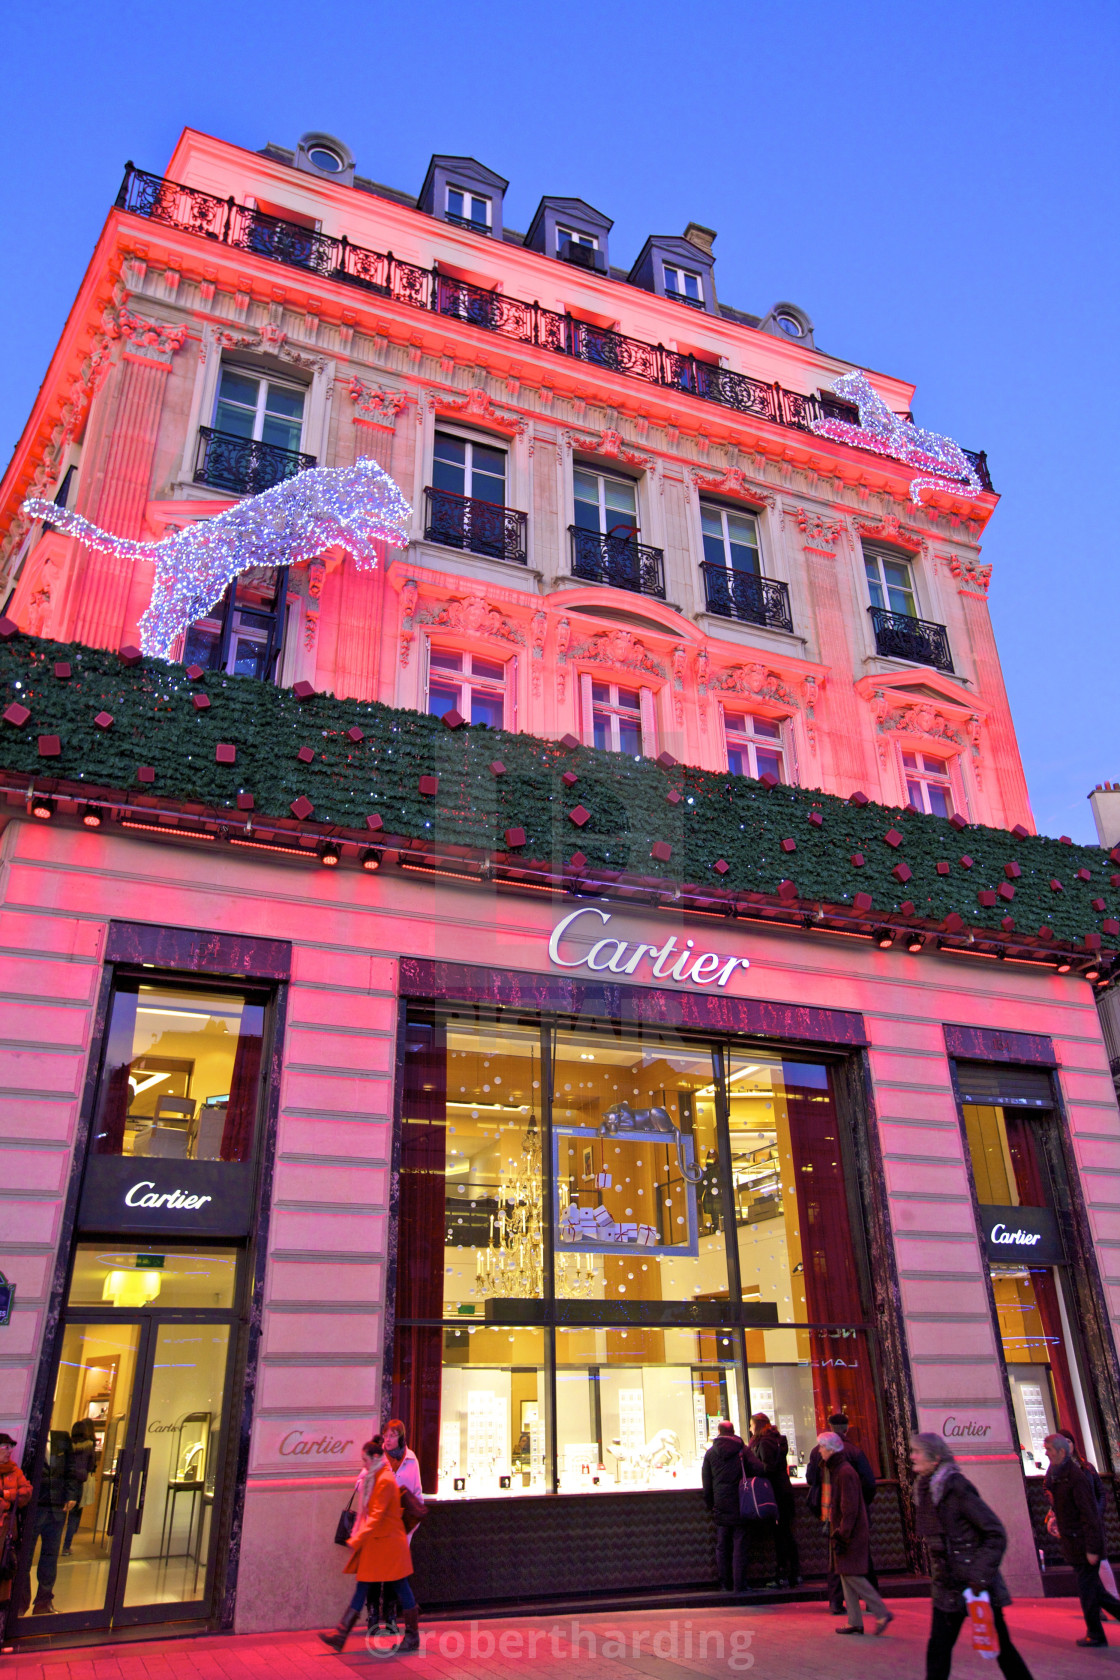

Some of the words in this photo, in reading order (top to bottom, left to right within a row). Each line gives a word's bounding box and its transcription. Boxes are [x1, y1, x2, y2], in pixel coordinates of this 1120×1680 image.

[549, 907, 750, 987] Cartier
[125, 1181, 212, 1209] Cartier
[991, 1223, 1041, 1245] Cartier
[943, 1416, 991, 1437] Cartier
[279, 1430, 354, 1456] Cartier
